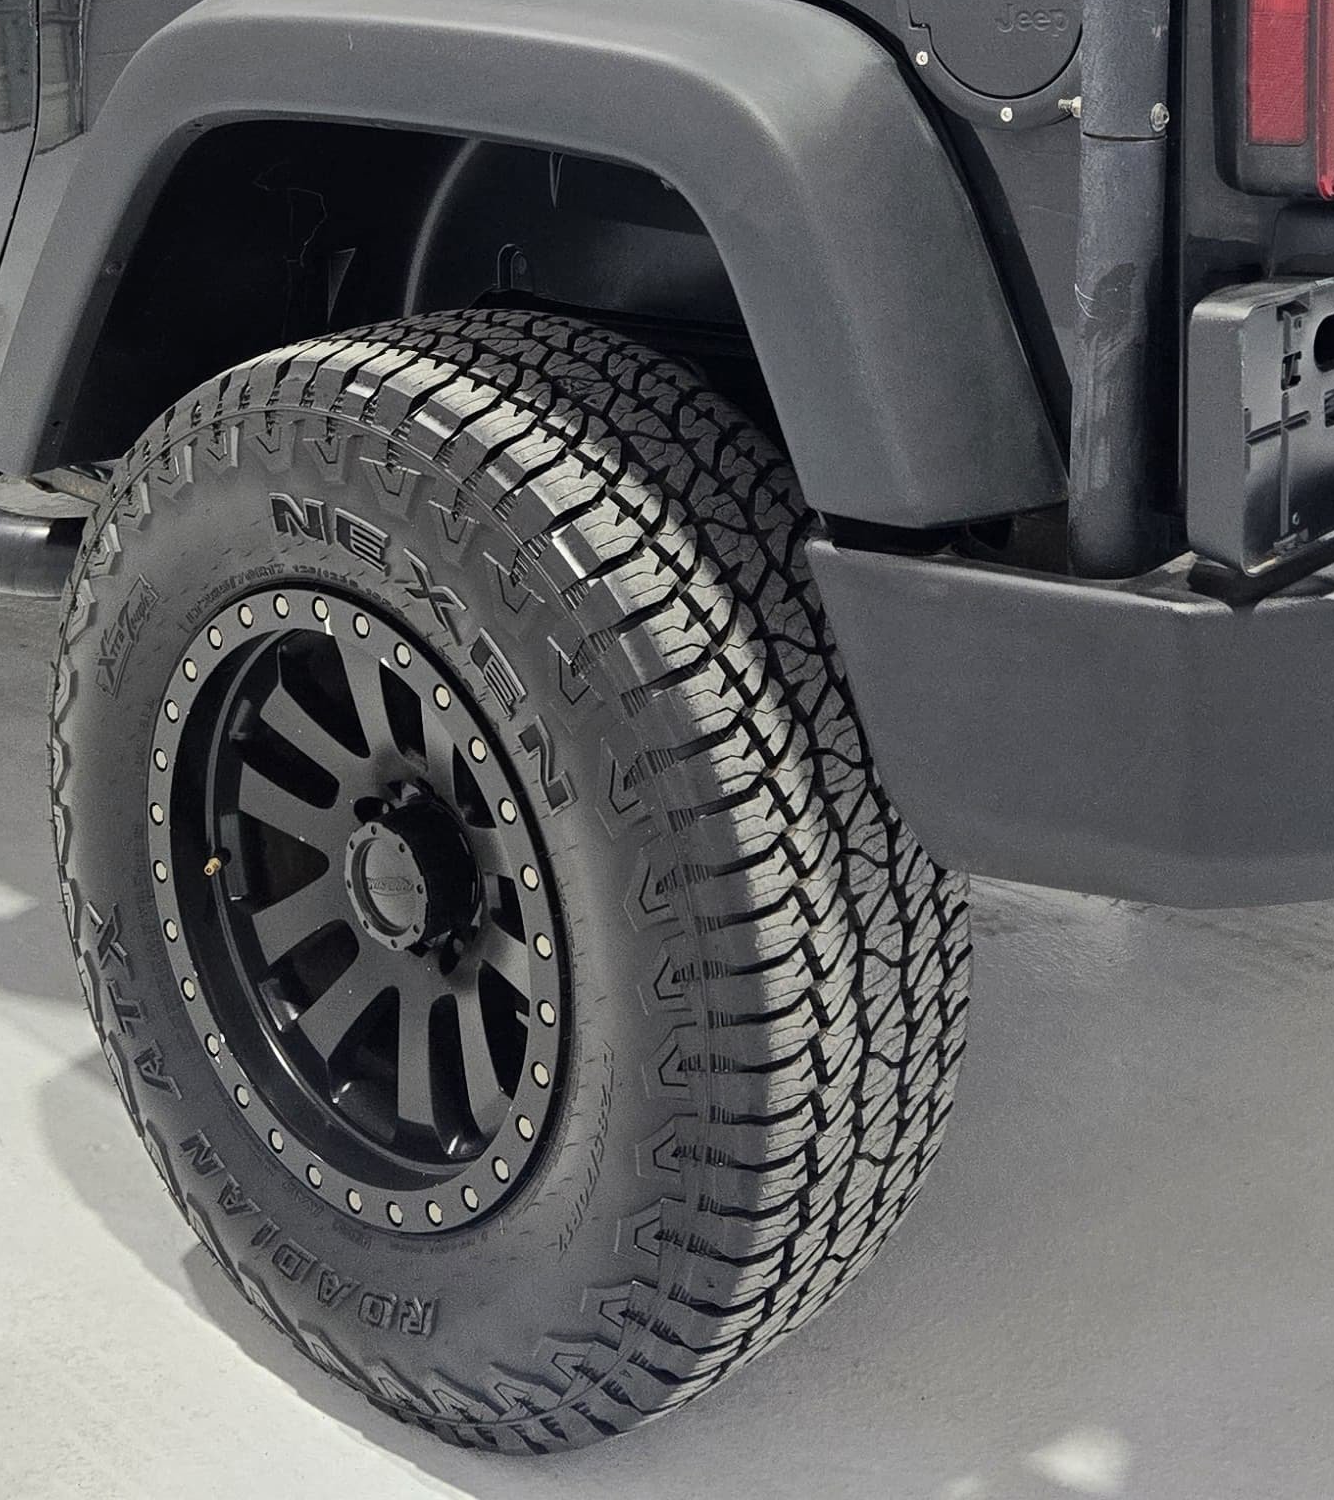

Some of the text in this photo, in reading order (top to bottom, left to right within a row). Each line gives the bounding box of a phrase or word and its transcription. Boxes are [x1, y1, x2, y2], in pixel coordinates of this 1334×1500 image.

[994, 2, 1068, 38] Jeep
[267, 491, 579, 818] NEXEN
[84, 900, 184, 1102] ATX
[179, 1126, 441, 1339] ROADIAN
